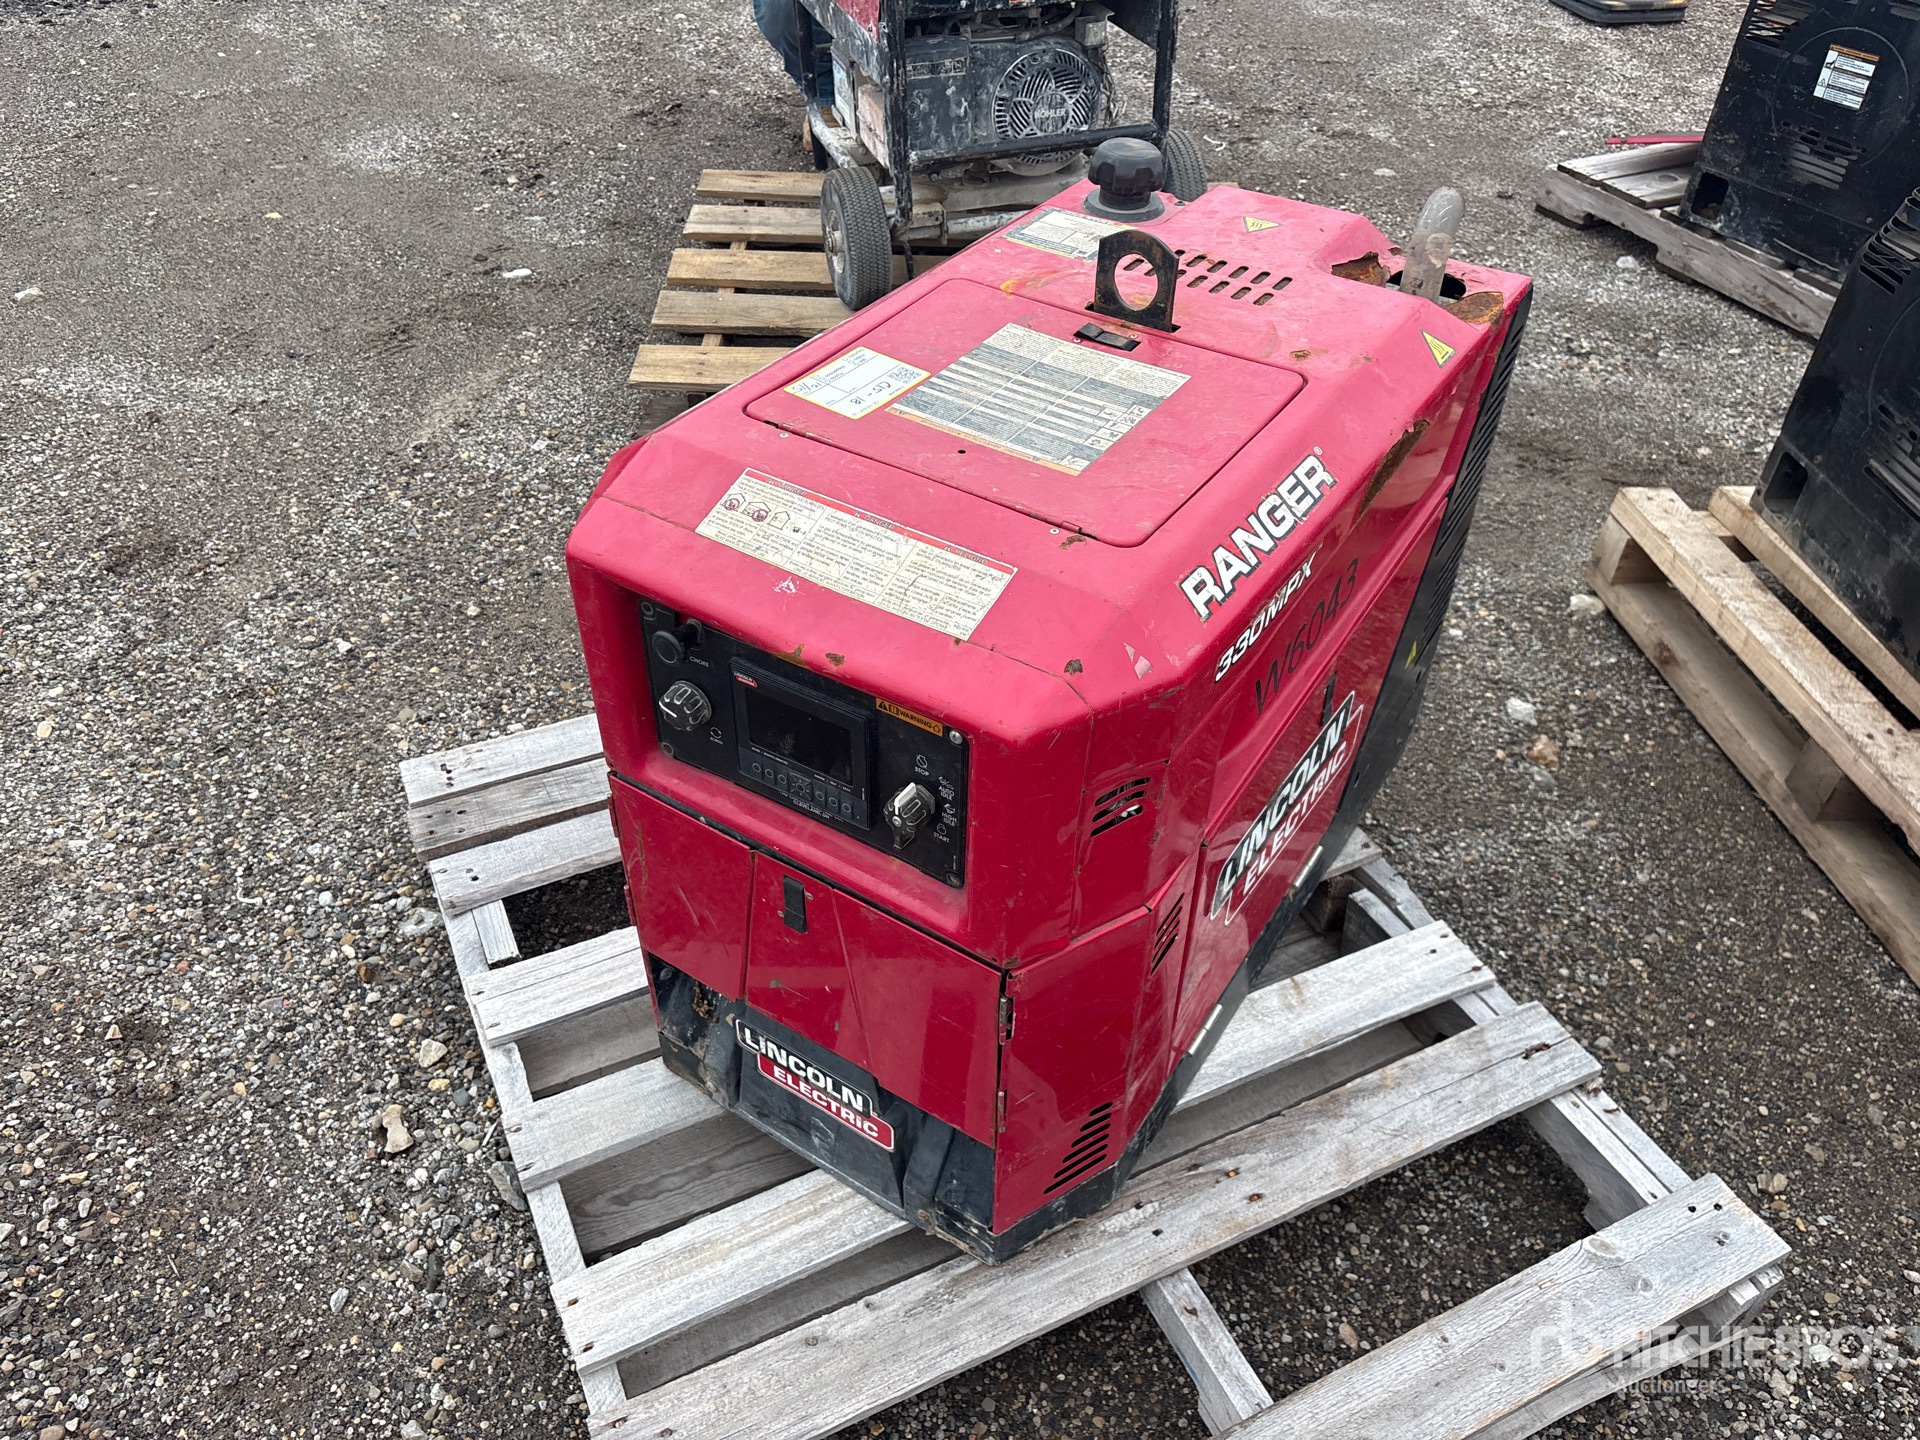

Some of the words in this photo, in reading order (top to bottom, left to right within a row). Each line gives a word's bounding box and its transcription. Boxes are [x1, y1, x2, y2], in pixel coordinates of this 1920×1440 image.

[1034, 108, 1066, 119] KOHLER
[863, 514, 895, 529] DANGER
[1179, 453, 1336, 622] RANGER
[1214, 552, 1317, 683] 330MPX
[1255, 557, 1359, 714] W6043
[898, 708, 933, 728] WARNING
[914, 766, 930, 777] STOP
[938, 785, 955, 797] AUTO
[940, 791, 953, 801] IDLE
[1221, 710, 1346, 897] LINCOLN
[941, 811, 957, 823] HIGH
[943, 818, 956, 827] IDLE
[1243, 740, 1347, 896] ELECTRIC
[933, 832, 950, 843] START
[743, 1026, 863, 1113] LINCOLN
[773, 1064, 879, 1138] ELECTRIC
